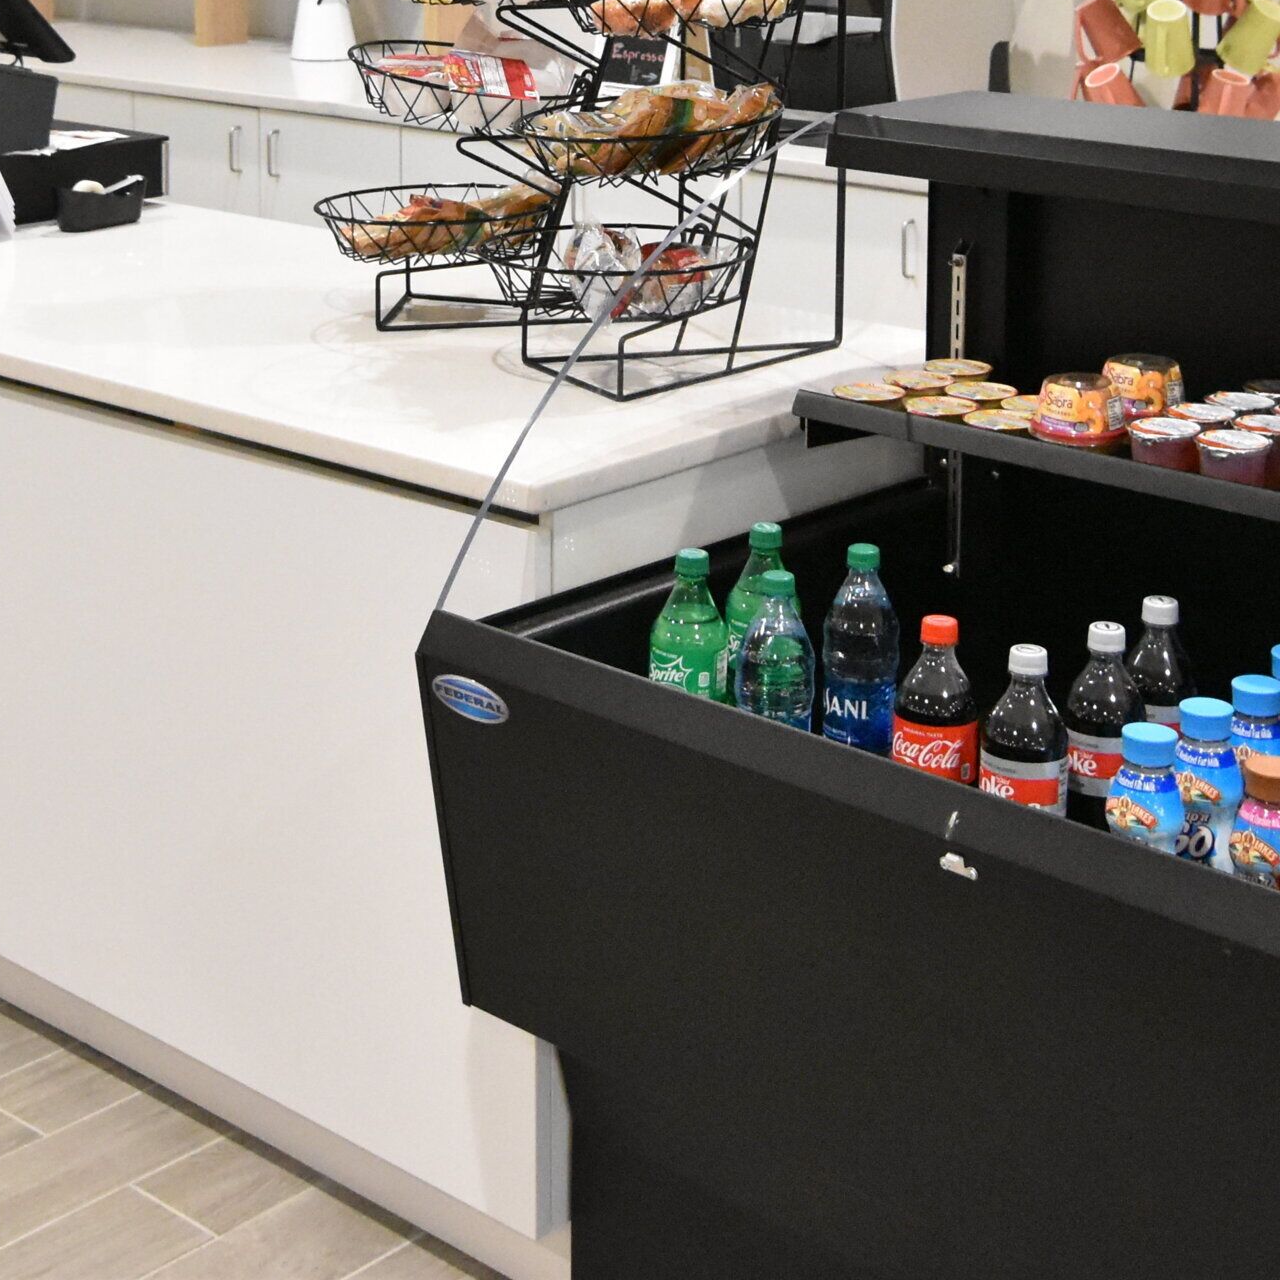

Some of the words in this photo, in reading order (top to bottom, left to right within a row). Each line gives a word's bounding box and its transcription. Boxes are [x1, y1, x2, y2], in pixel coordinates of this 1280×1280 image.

[611, 42, 665, 63] Espresso
[1111, 367, 1134, 386] Sabra
[1046, 391, 1073, 409] Sabra
[649, 664, 685, 684] Sprite
[436, 683, 504, 715] FEDERAL
[823, 686, 868, 720] SANI
[926, 731, 943, 739] TASTE
[892, 730, 963, 770] Coca-Cola
[980, 776, 1015, 799] oke
[1195, 777, 1220, 802] LAKES
[1130, 802, 1156, 830] LAKES
